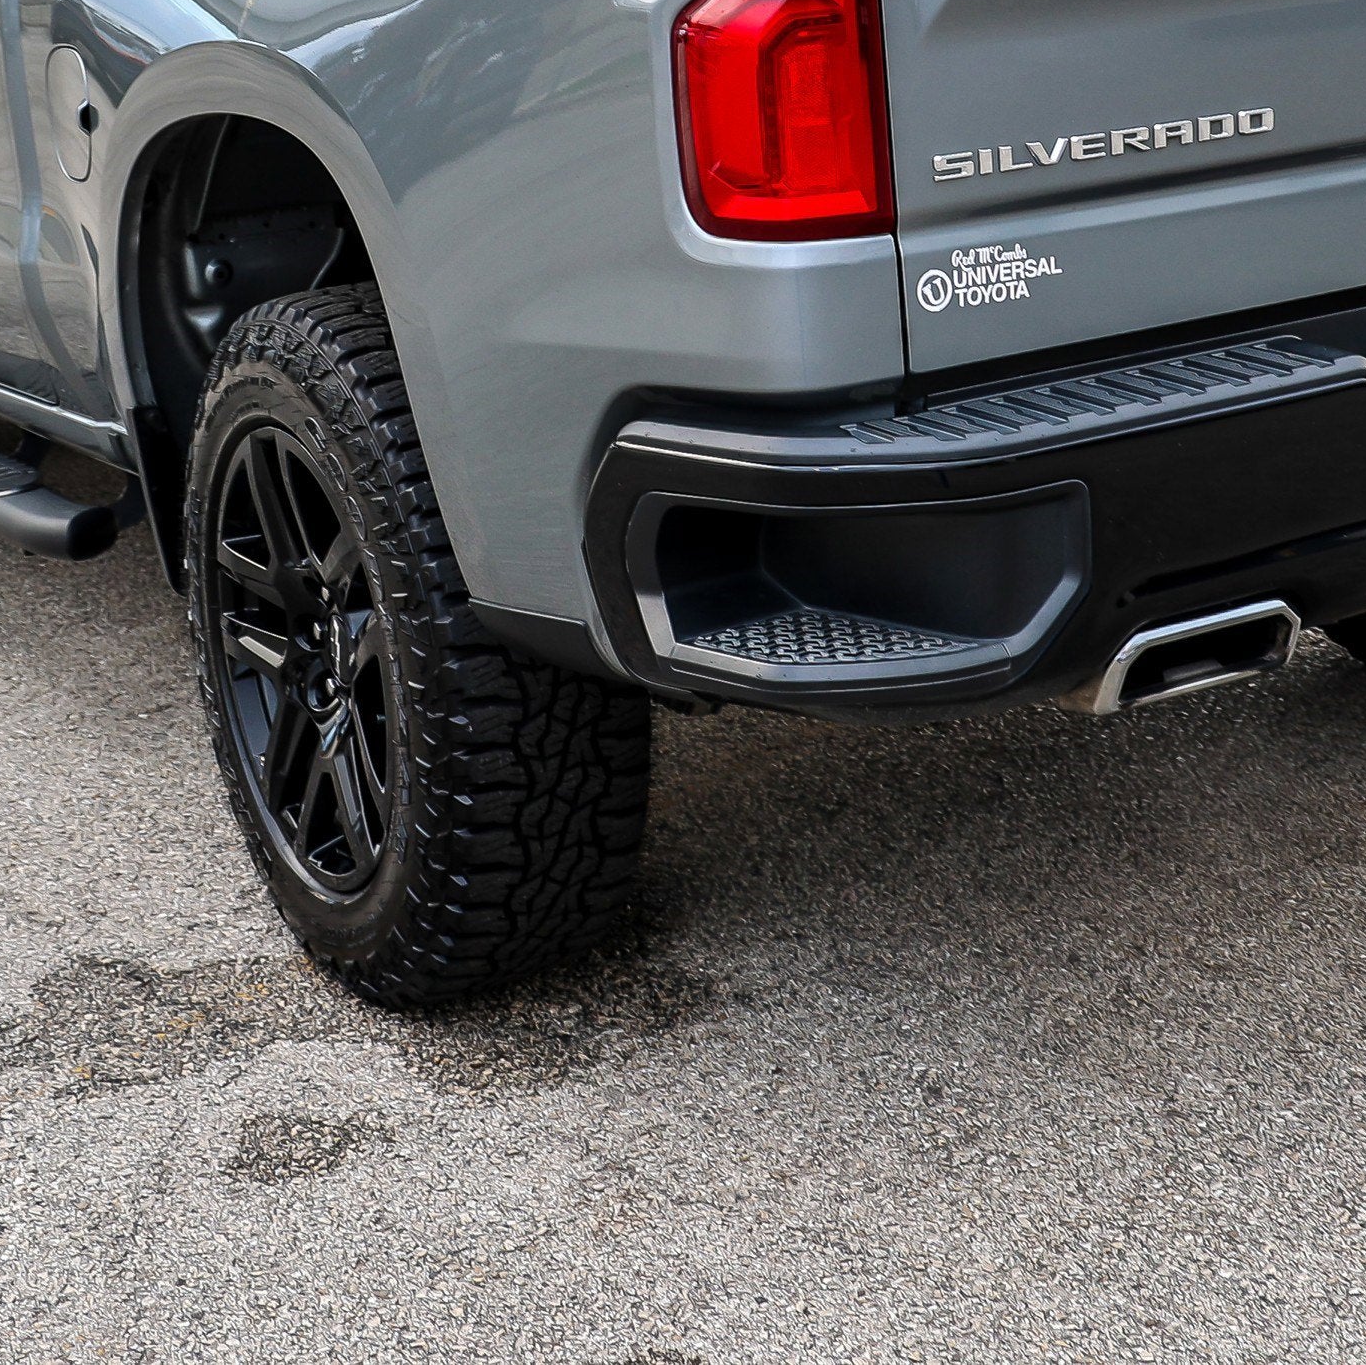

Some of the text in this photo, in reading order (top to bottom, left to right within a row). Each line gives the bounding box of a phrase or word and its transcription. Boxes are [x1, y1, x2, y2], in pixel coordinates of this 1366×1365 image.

[933, 107, 1276, 182] SILVERADO
[951, 249, 976, 272] Red
[952, 256, 1063, 288] UNIVERSAL
[954, 279, 1030, 307] TOYOTA
